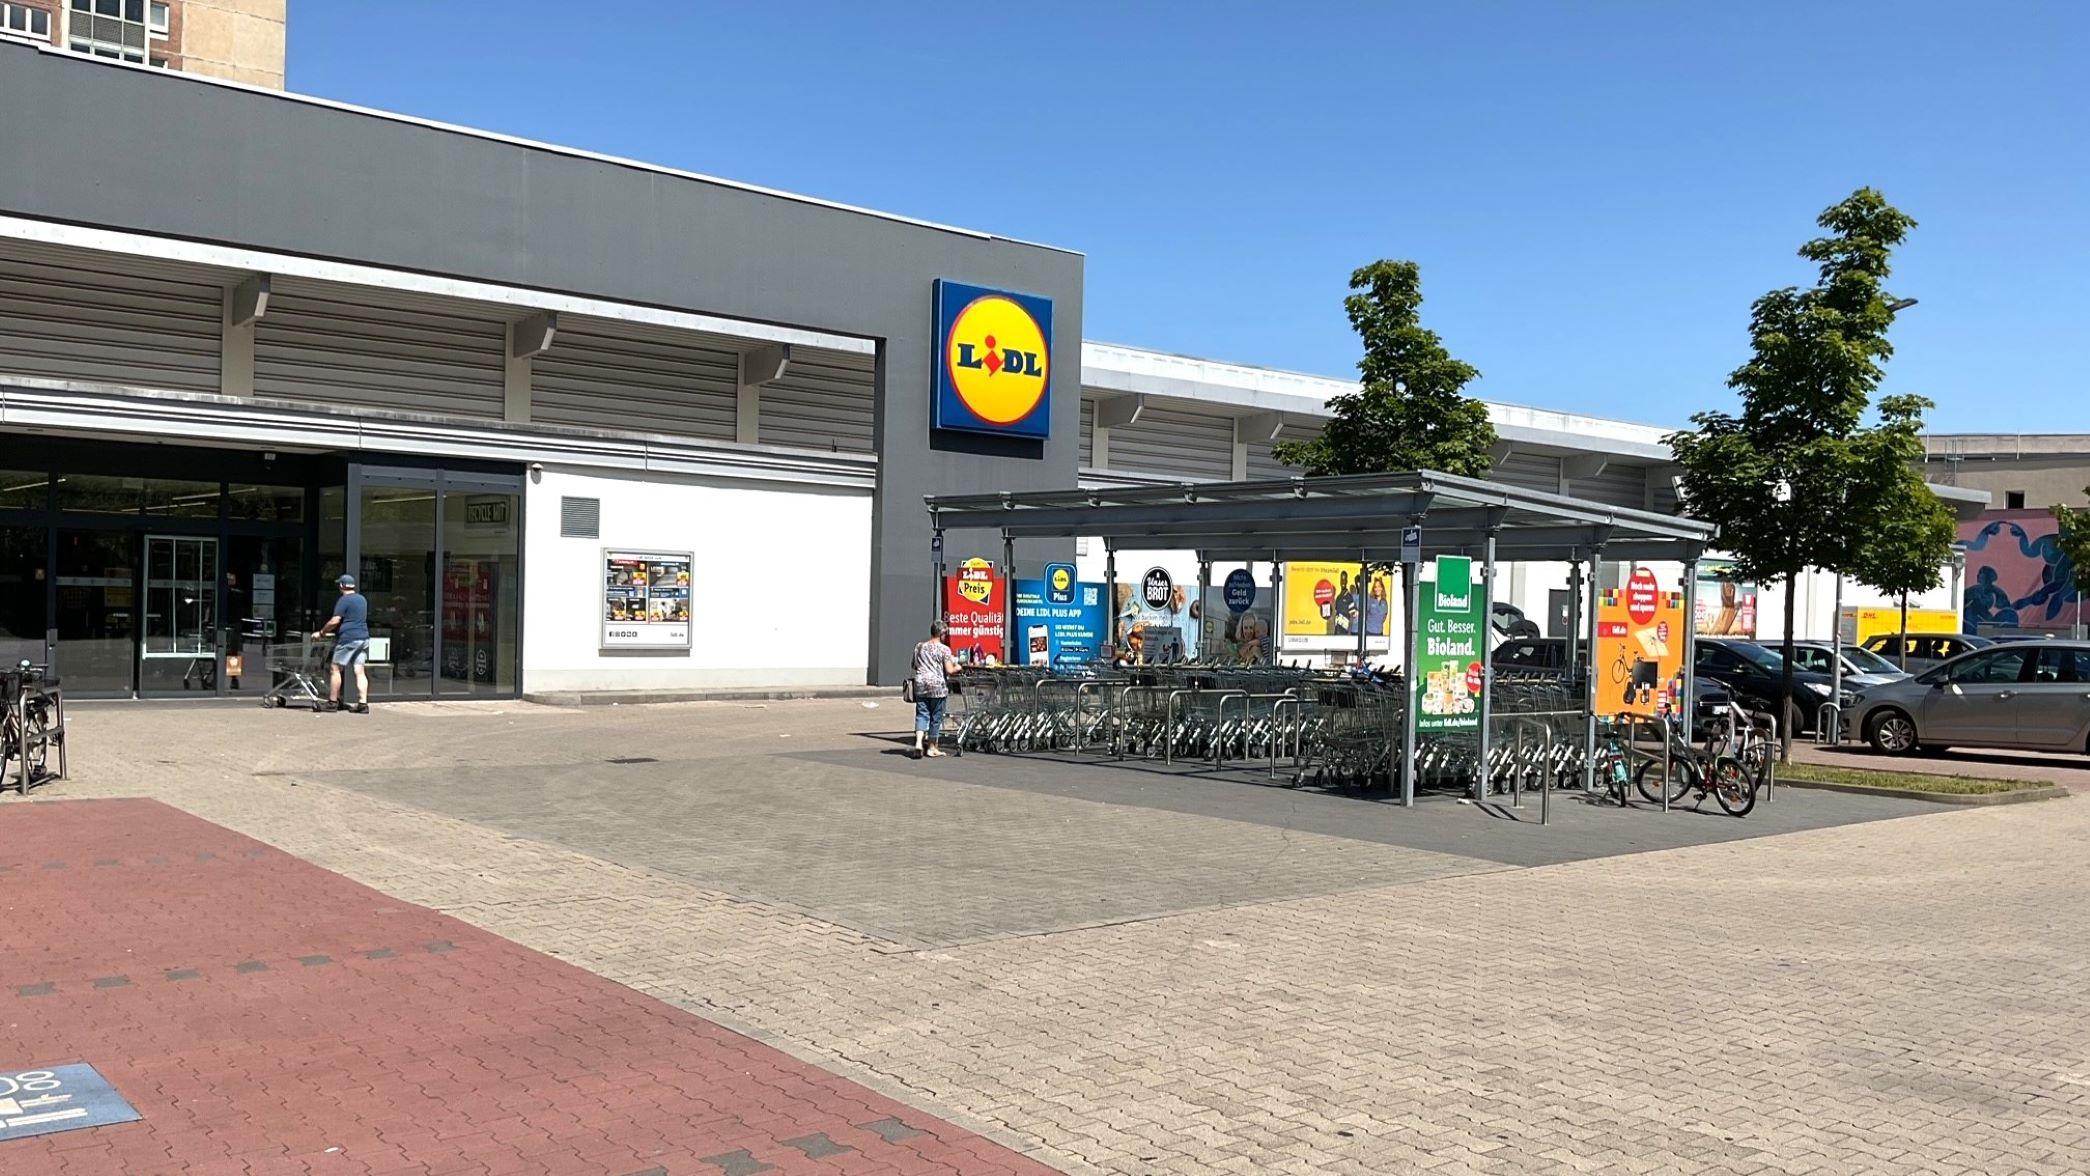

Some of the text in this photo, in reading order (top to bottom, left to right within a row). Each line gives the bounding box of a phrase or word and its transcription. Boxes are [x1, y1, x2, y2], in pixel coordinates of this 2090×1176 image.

[957, 334, 1042, 377] LIDL
[962, 567, 989, 580] LIDL
[1147, 576, 1168, 587] Unser
[963, 582, 986, 594] Preis
[1147, 587, 1169, 601] BROT
[1232, 588, 1247, 596] Geld
[1053, 592, 1068, 601] Plus
[1228, 597, 1250, 605] zurück
[1437, 592, 1468, 607] Bioland
[1036, 608, 1051, 617] LIDL
[1052, 608, 1068, 618] PLUS
[1069, 609, 1082, 618] APP
[947, 625, 972, 636] mmer
[1427, 618, 1476, 633] Gut. Besser.
[1427, 637, 1476, 656] Bioland.
